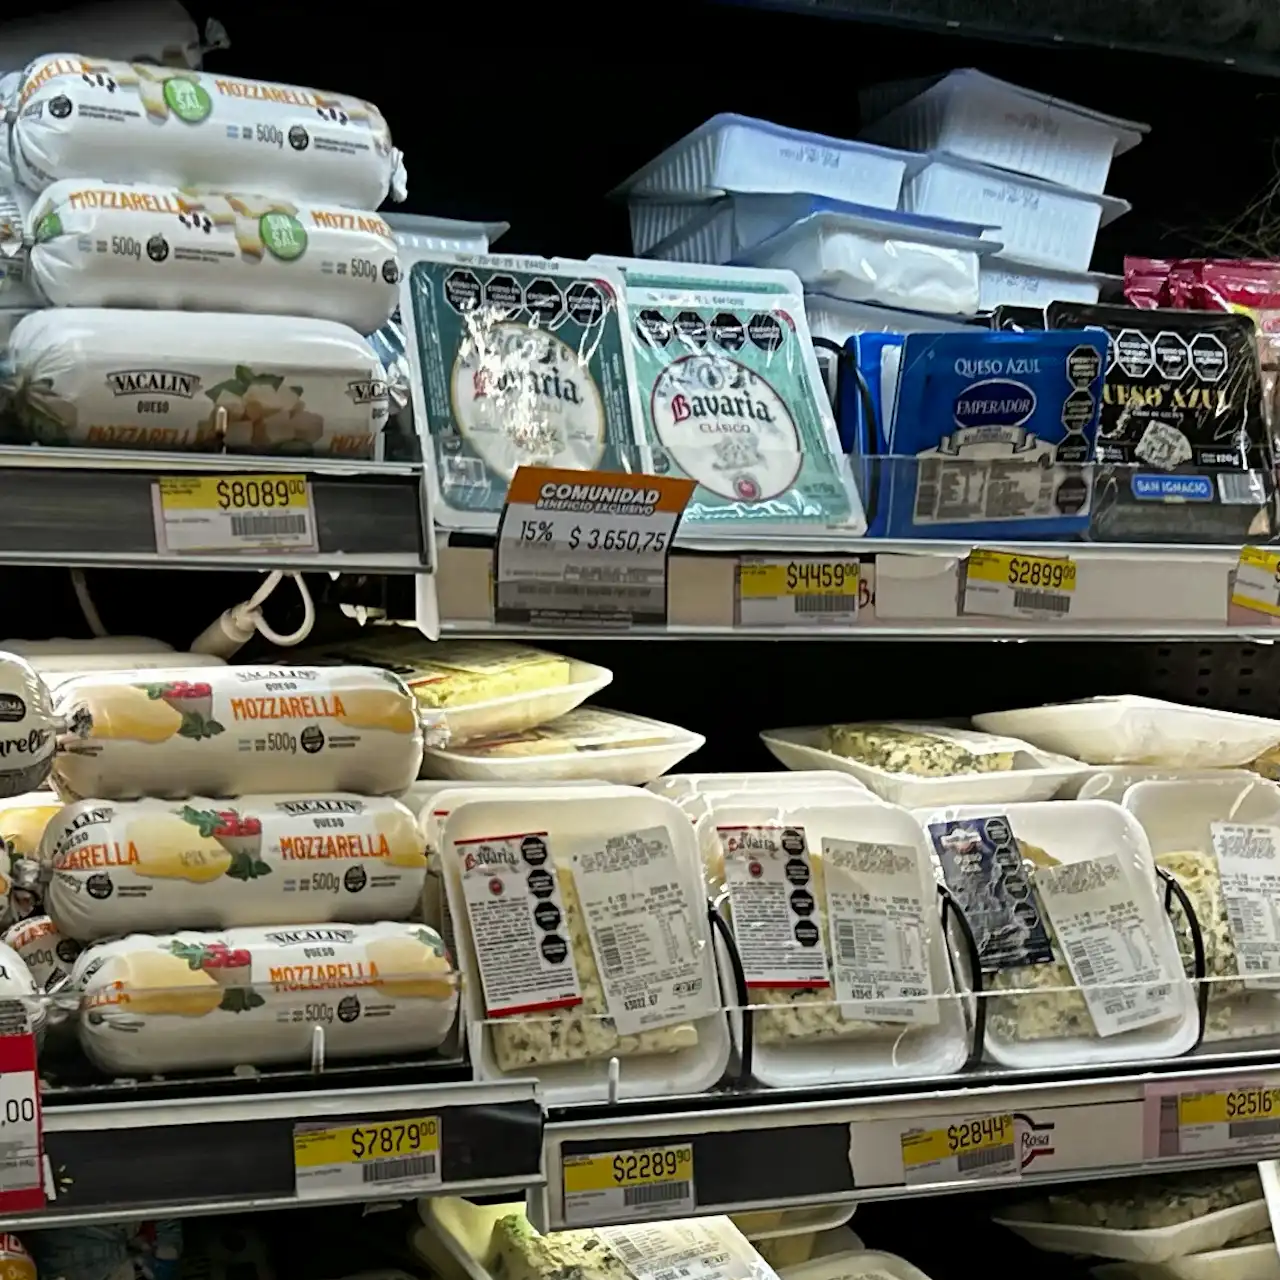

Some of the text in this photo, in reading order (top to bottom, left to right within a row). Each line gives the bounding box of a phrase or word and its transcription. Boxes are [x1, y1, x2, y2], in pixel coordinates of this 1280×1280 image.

[256, 124, 284, 148] 500g
[112, 239, 141, 260] 500g
[351, 260, 377, 282] 500g
[955, 358, 1041, 378] QUESO AZUL
[115, 372, 194, 394] VACALIN
[671, 390, 775, 425] Bavaria
[956, 399, 1030, 415] EMPERADOR
[541, 483, 660, 504] COMUNIDAD
[536, 500, 654, 515] BENEFICIO EXCLUSIVO
[521, 520, 553, 542] 15%
[231, 697, 346, 721] MOZZARELLA
[268, 733, 297, 755] 500g
[285, 802, 358, 815] VACALIN
[280, 834, 391, 860] MOZZARELLA
[312, 873, 340, 894] 500g
[273, 929, 347, 944] VACALIN
[270, 962, 383, 992] MOZZARELLA
[305, 1003, 334, 1023] 500g
[1021, 1131, 1049, 1149] Rosa
